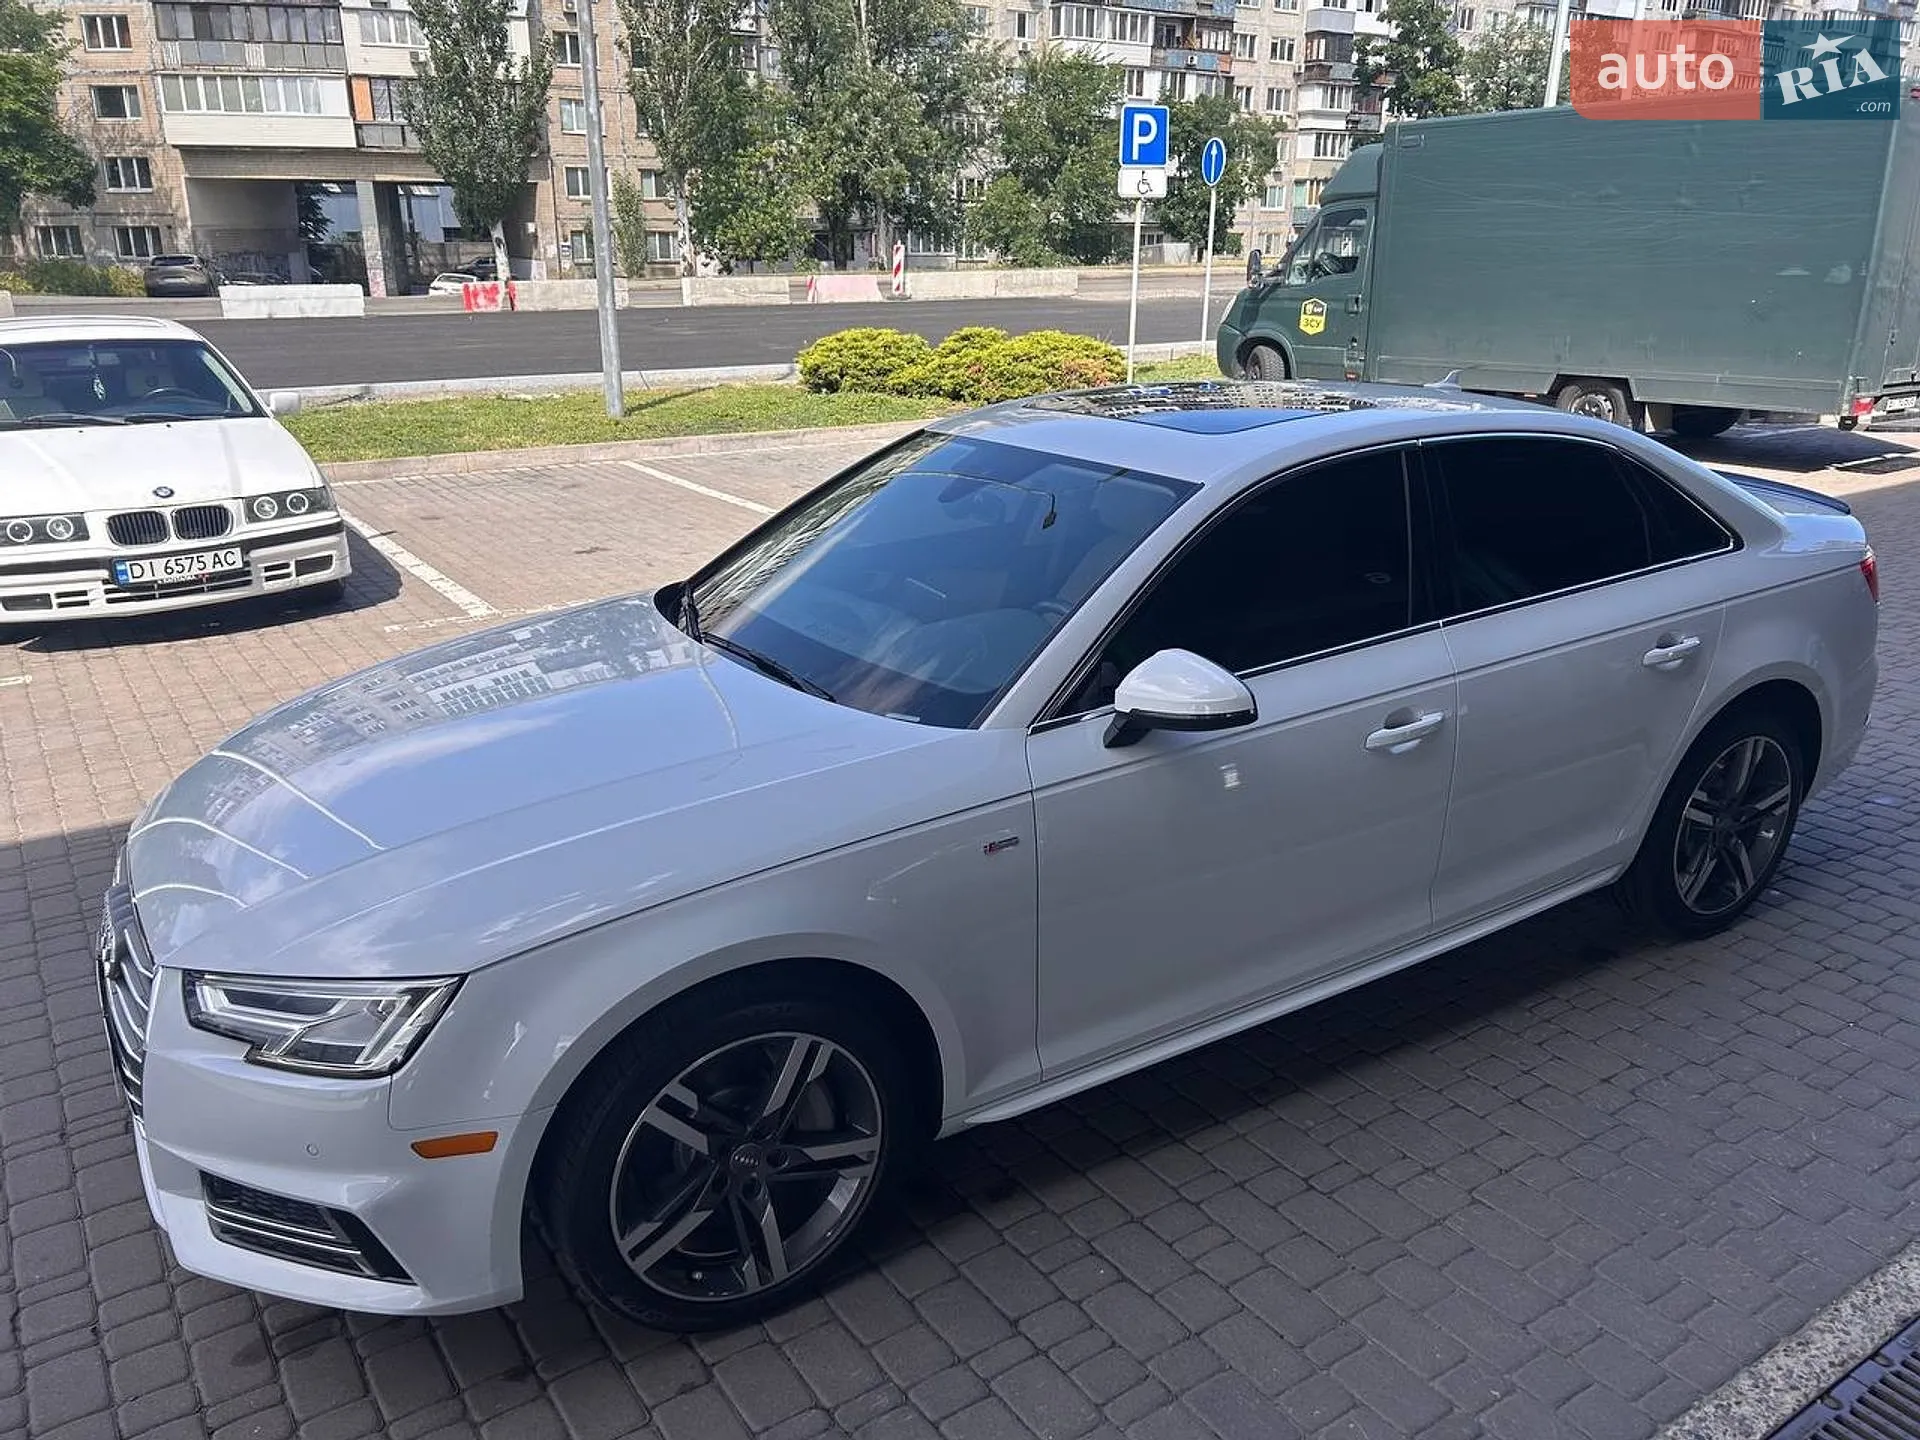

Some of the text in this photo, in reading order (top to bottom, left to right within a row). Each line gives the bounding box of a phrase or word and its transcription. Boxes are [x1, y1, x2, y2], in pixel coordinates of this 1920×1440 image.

[1132, 112, 1158, 161] P
[128, 561, 156, 579] DI
[163, 554, 207, 576] 6575
[211, 550, 236, 569] AC
